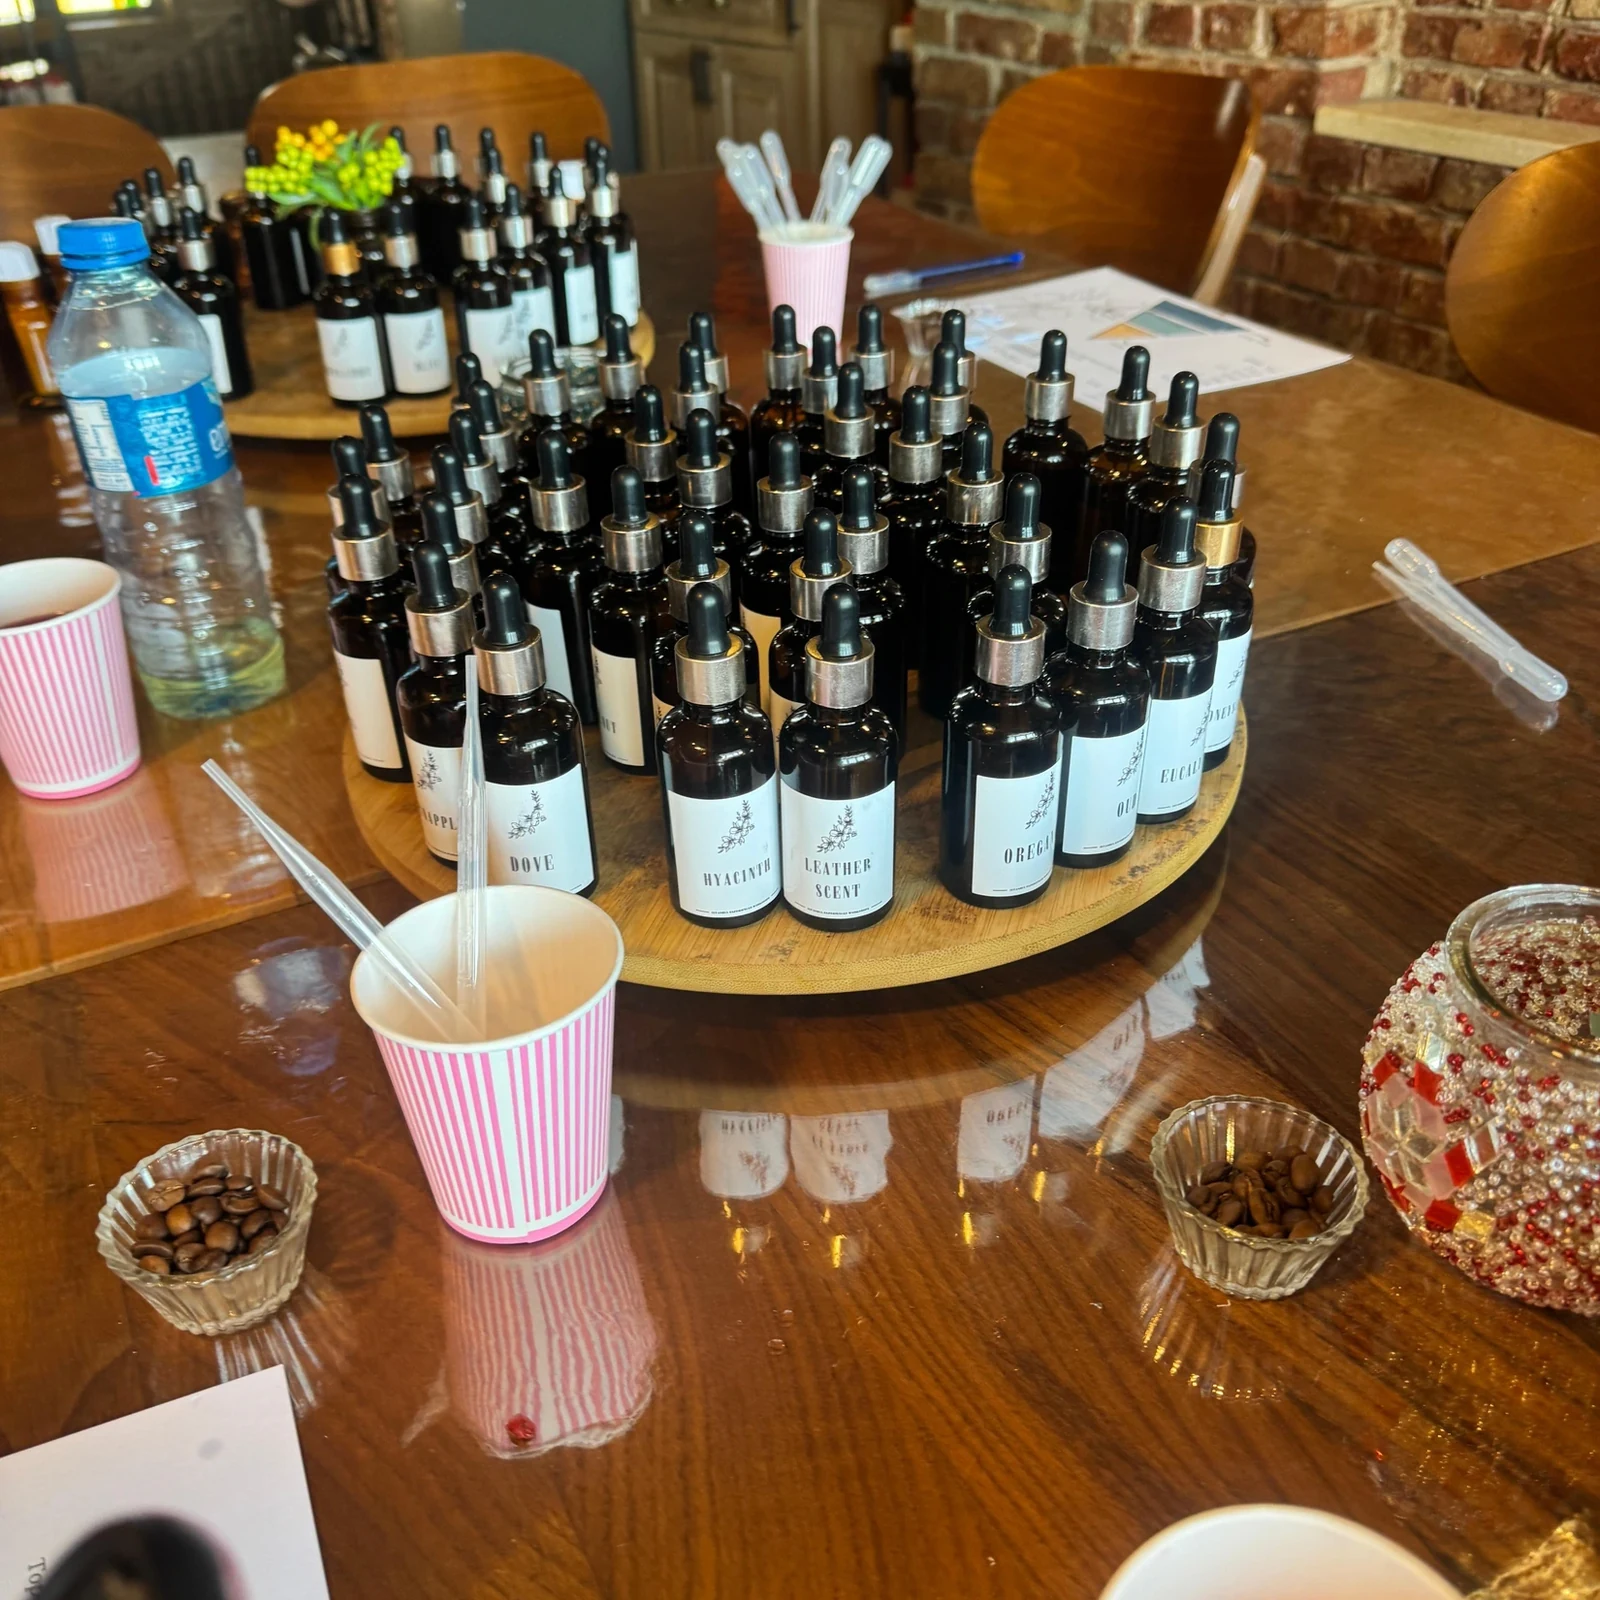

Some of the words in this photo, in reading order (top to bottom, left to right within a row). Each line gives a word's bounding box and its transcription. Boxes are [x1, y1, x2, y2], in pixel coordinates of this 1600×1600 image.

[510, 853, 556, 874] DOVE
[703, 856, 772, 887] HYACINTH
[804, 856, 872, 877] LEATHER
[814, 882, 862, 900] SCENT
